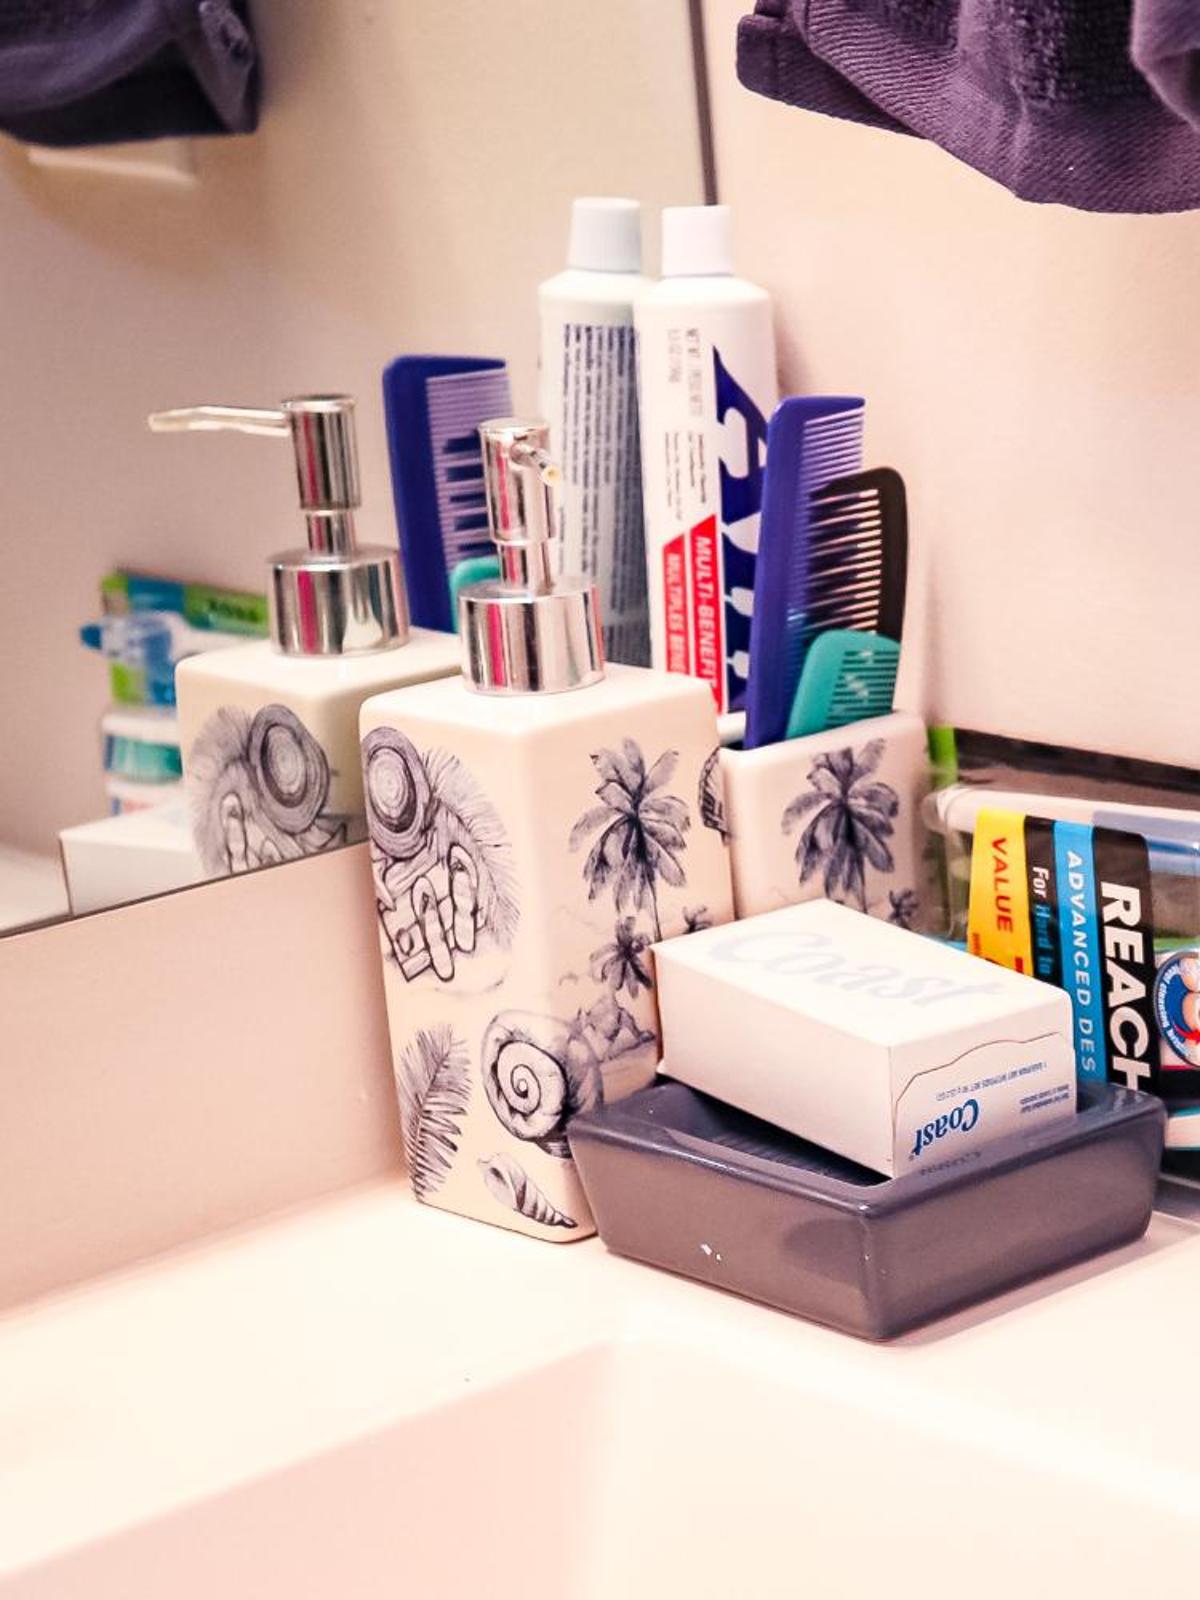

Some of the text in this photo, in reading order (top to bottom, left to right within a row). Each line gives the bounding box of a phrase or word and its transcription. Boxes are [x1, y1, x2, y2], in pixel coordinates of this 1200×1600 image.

[991, 837, 1014, 933] VALUE
[1032, 866, 1050, 897] For
[708, 930, 1006, 1008] Coast
[1066, 850, 1091, 1008] ADVANCED
[1100, 881, 1153, 1093] REACH
[914, 1098, 981, 1155] Coast
